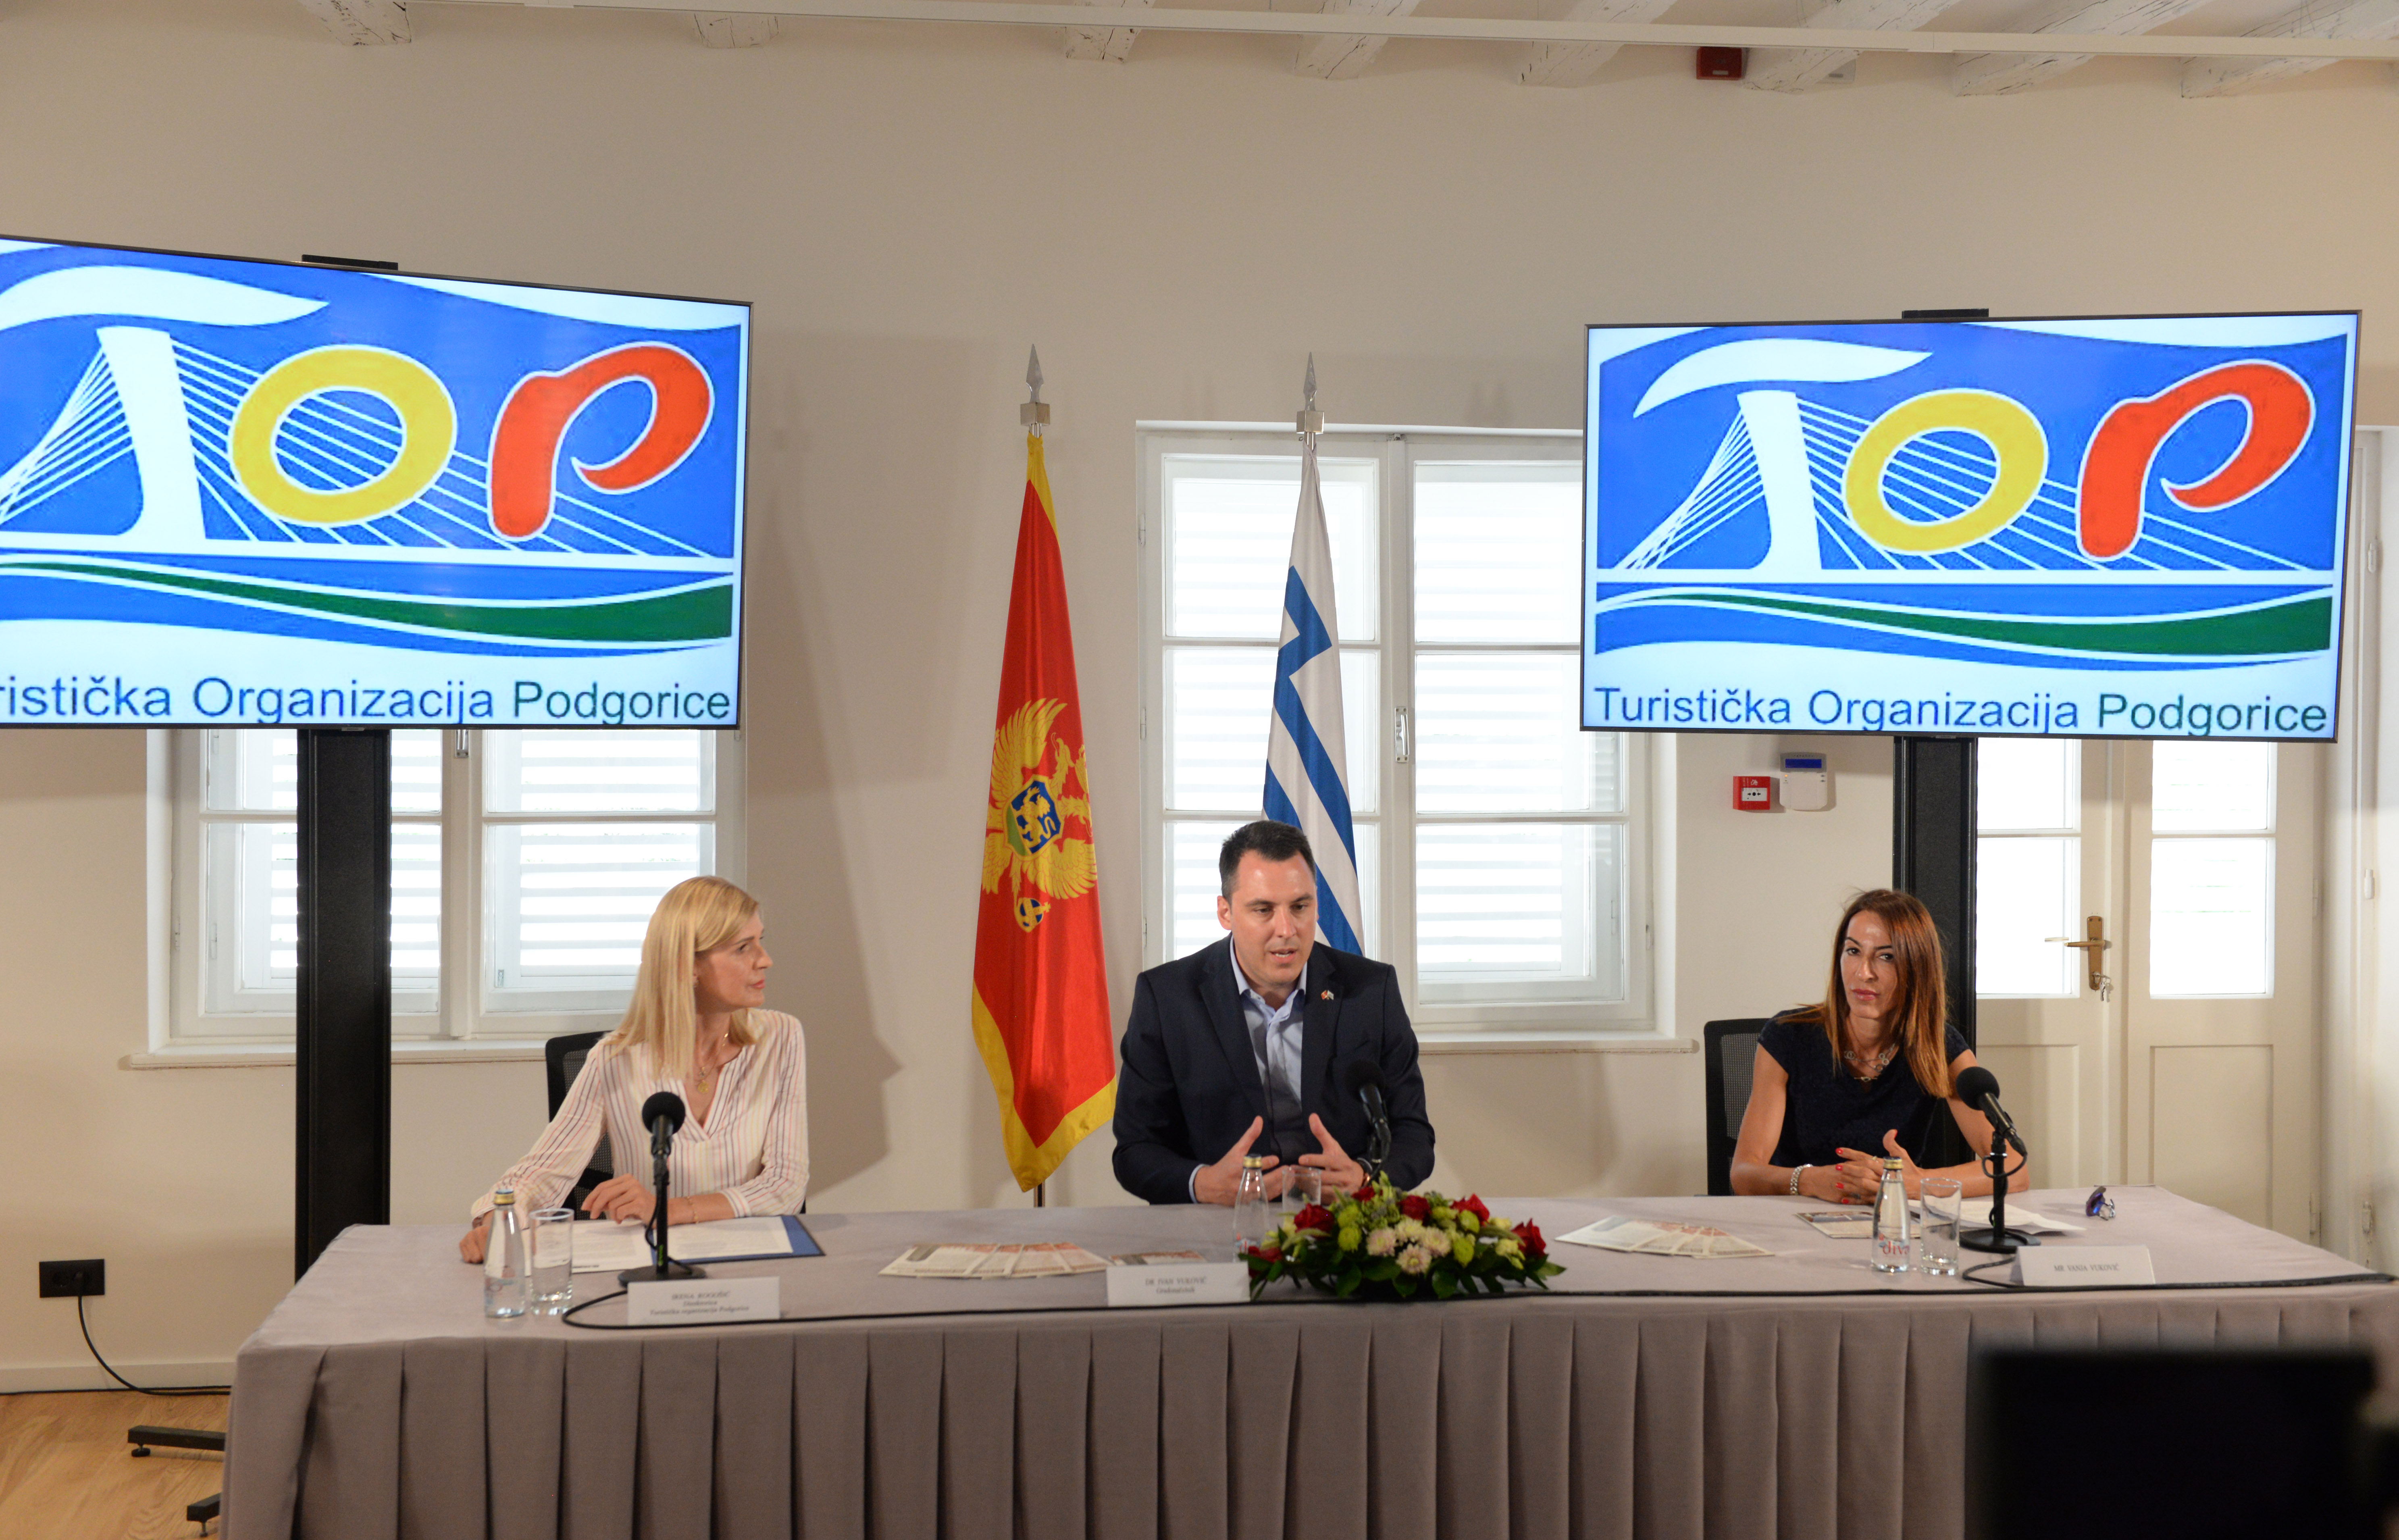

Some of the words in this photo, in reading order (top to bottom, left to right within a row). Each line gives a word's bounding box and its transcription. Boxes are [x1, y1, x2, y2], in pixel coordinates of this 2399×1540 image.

[0, 676, 171, 716] istička
[194, 676, 493, 724] Organizacija
[514, 681, 730, 724] Podgorice
[1594, 687, 1790, 724] Turistička
[1808, 689, 2078, 733] Organizacija
[2099, 693, 2326, 736] Podgorice
